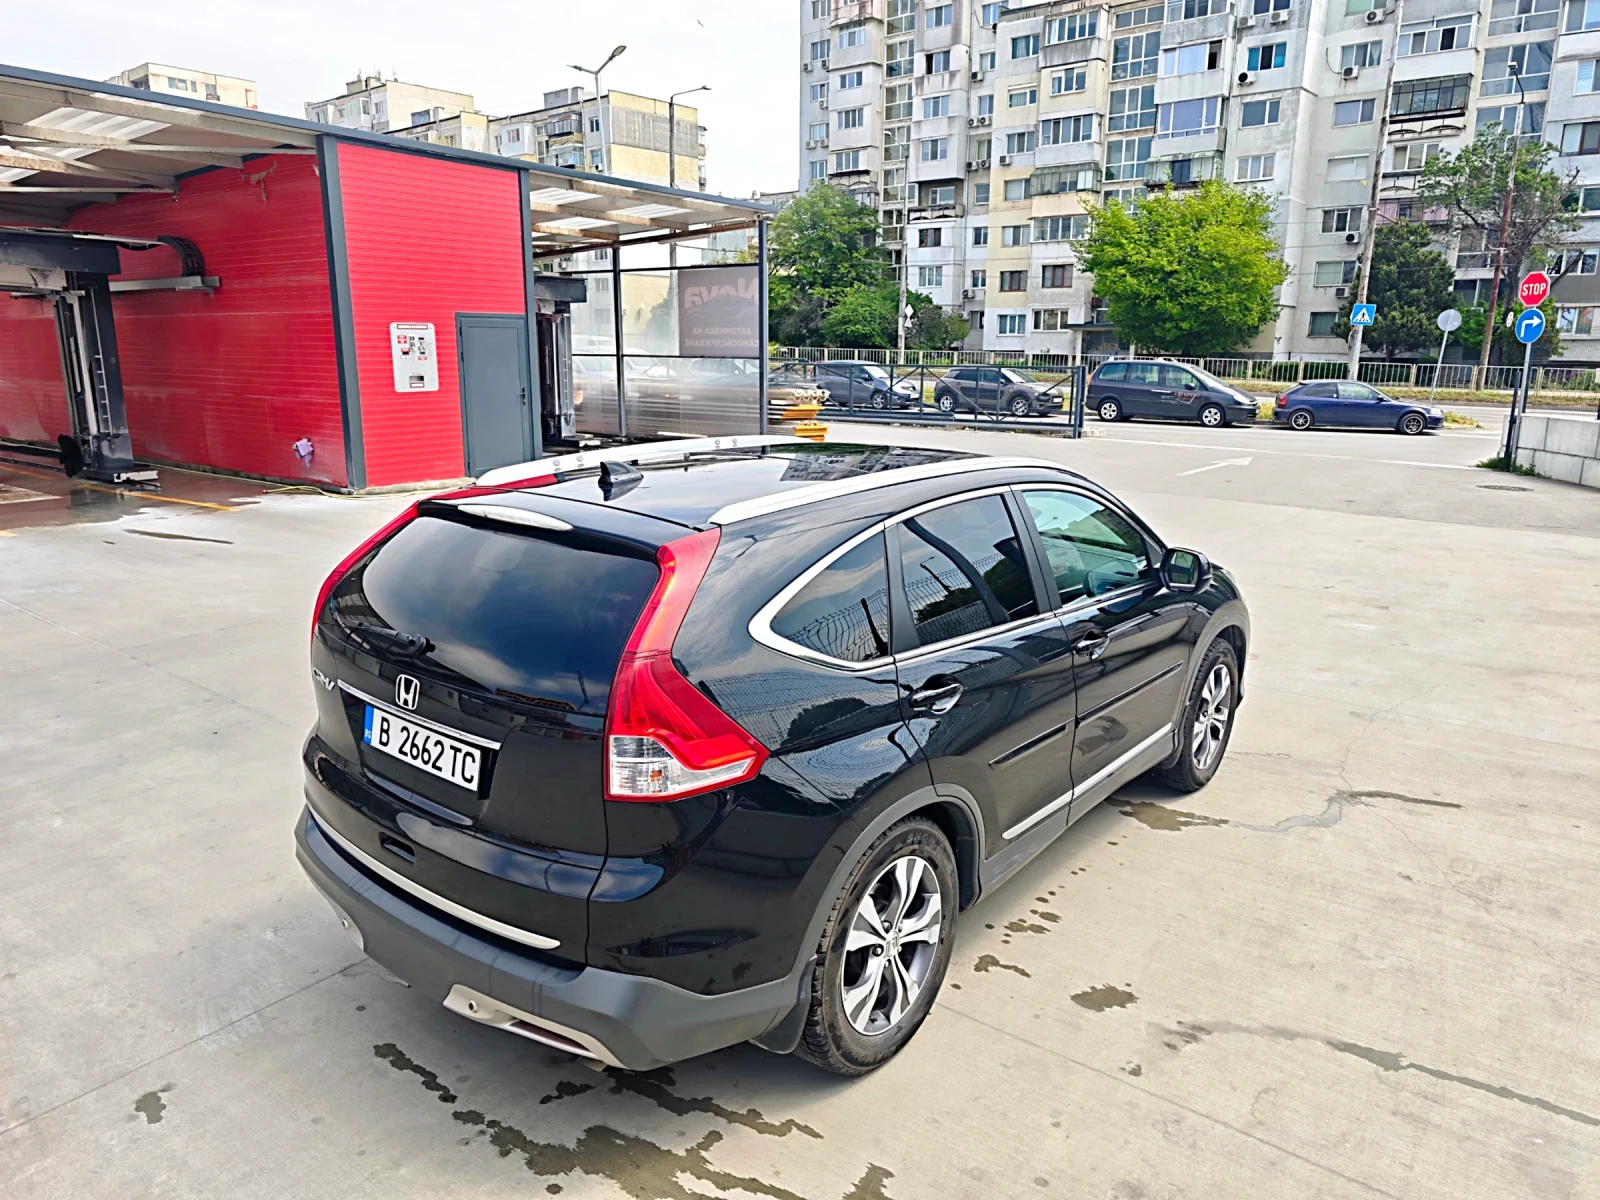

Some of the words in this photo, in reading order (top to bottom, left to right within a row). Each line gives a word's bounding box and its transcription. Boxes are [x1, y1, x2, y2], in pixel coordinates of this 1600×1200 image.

[1522, 283, 1546, 296] STOP
[364, 728, 372, 740] BG
[379, 716, 391, 747] B
[398, 726, 444, 773] 2662
[449, 745, 476, 784] TC
